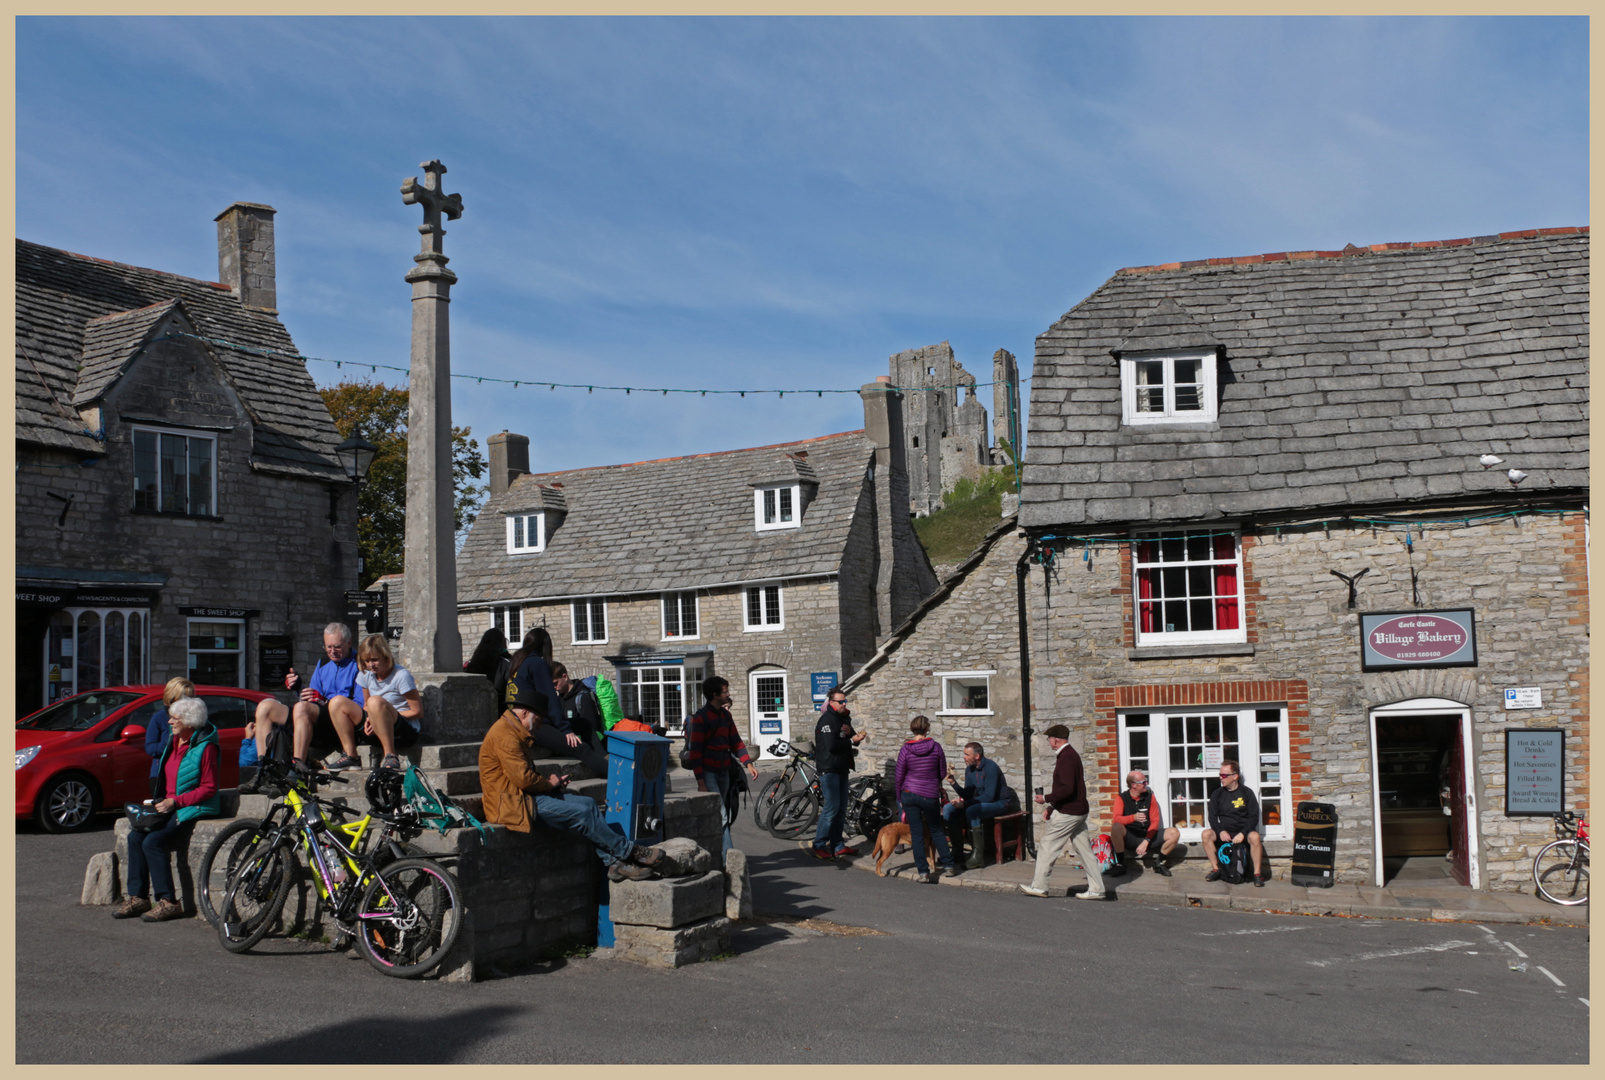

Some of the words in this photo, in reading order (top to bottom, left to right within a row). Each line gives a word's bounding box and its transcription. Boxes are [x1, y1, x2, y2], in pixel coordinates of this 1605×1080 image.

[38, 594, 60, 603] SHOP
[1374, 632, 1414, 646] Village
[1417, 631, 1461, 646] Bakery
[1508, 690, 1515, 699] P
[1298, 812, 1333, 822] PURBECK
